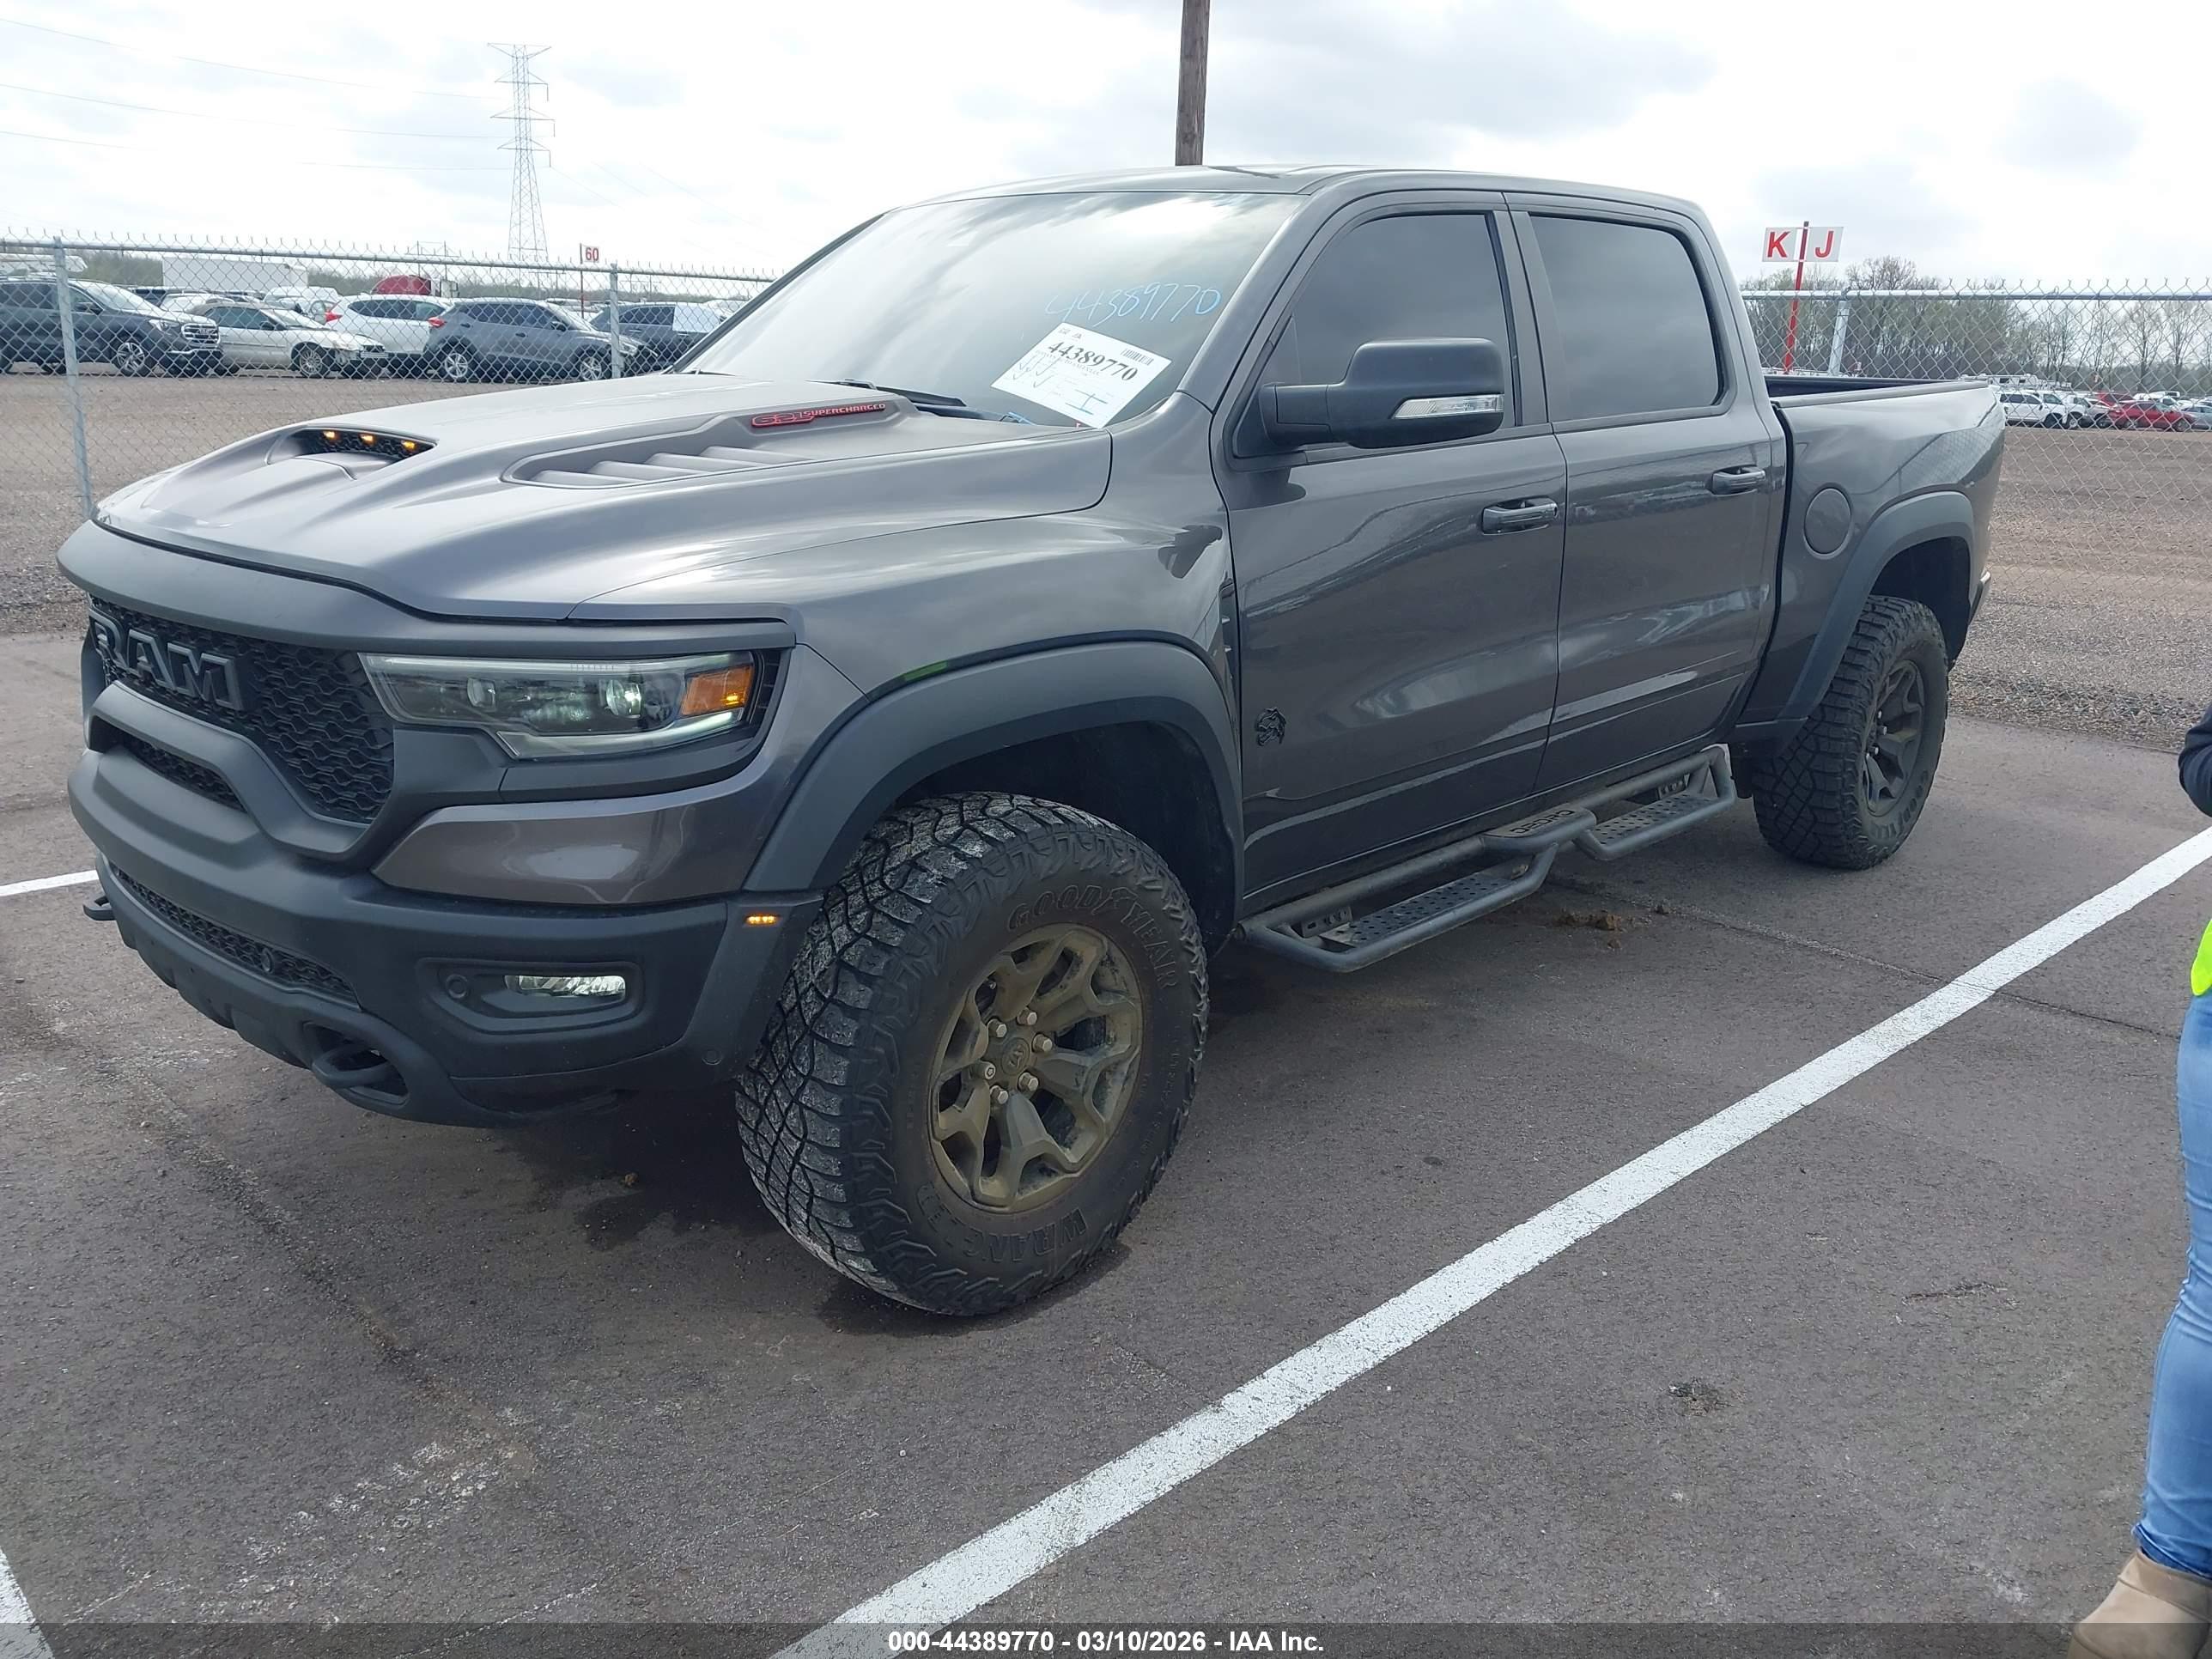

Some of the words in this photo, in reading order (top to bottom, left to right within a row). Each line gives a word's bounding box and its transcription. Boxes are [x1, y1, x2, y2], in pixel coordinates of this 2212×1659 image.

[586, 246, 599, 261] 60
[1767, 231, 1790, 258] K
[1814, 230, 1834, 258] J
[1045, 282, 1222, 327] 44389770
[1048, 342, 1139, 381] 44389770
[88, 608, 245, 712] RAM
[1007, 884, 1177, 988] GOODYEAR
